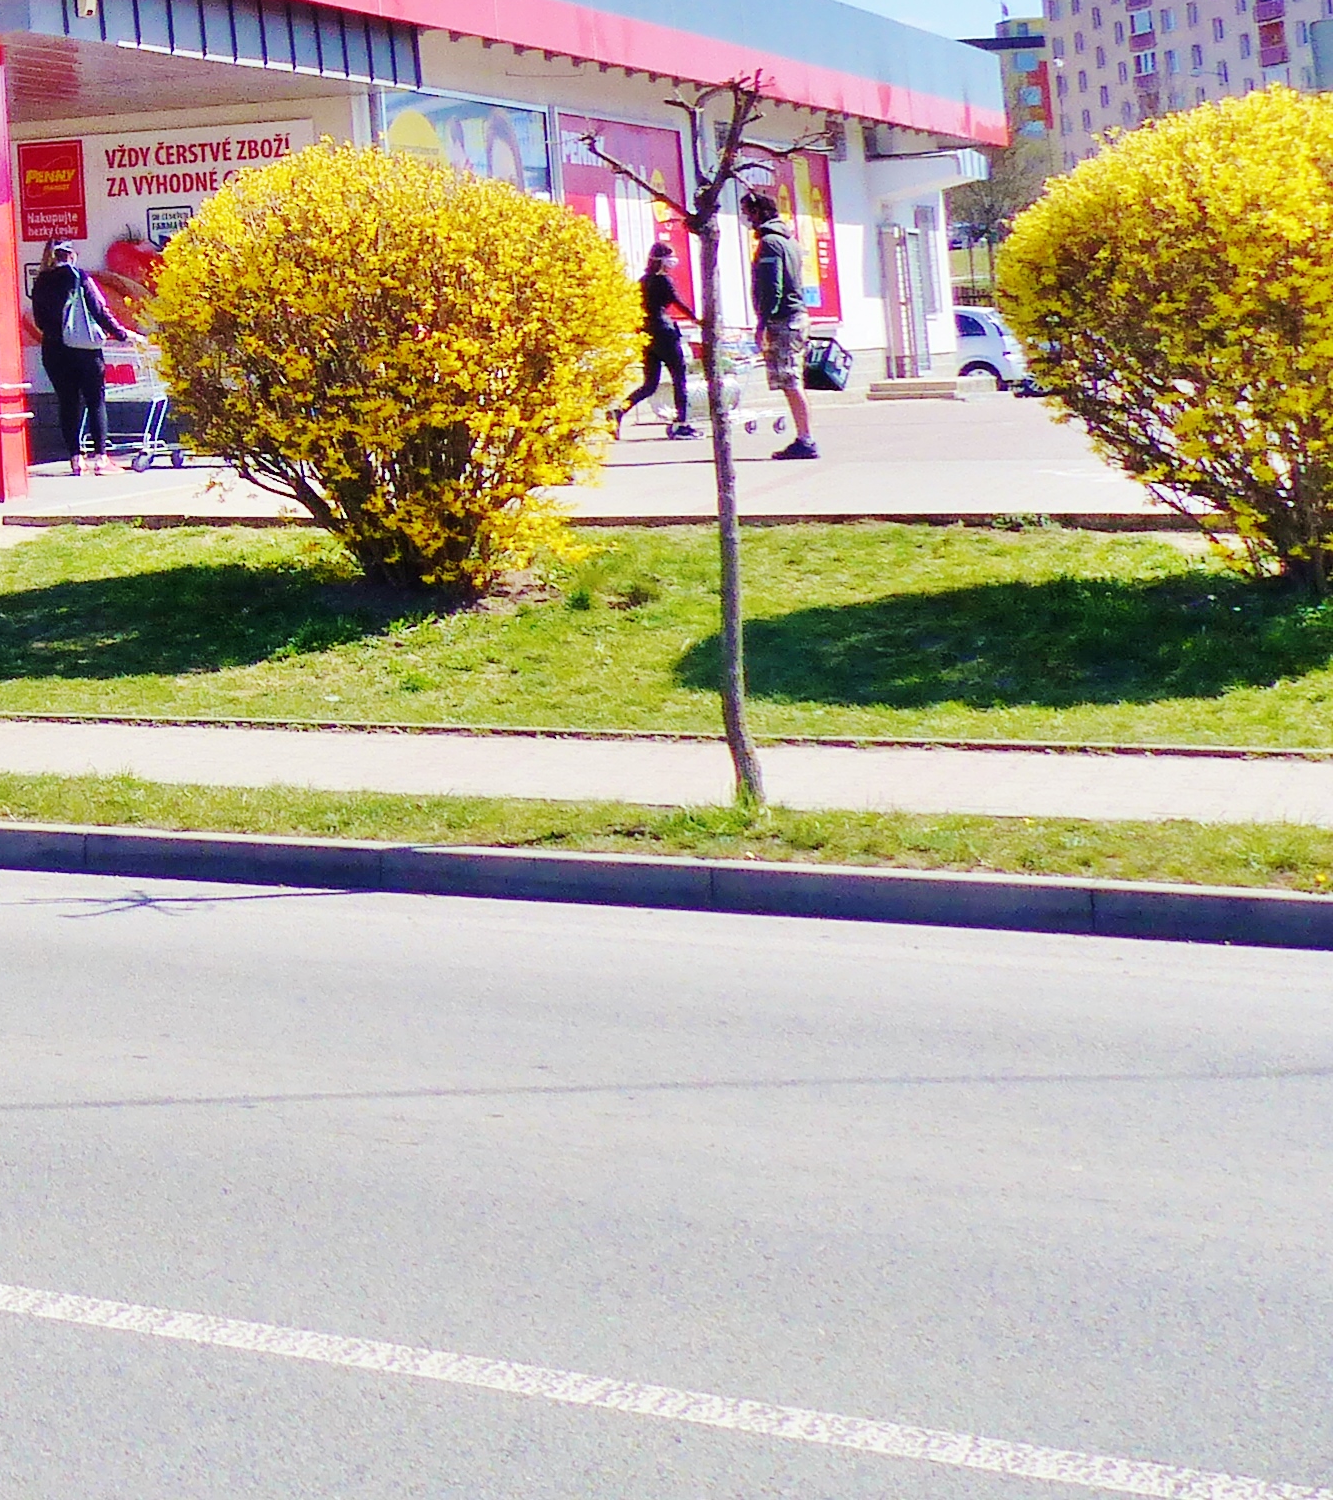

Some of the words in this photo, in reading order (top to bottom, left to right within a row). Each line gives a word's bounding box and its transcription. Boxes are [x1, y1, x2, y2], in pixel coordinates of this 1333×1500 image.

[105, 144, 151, 168] VŽDY
[154, 136, 232, 166] ČERSTVÉ
[236, 132, 291, 160] ZBOŽÍ
[25, 168, 76, 185] PENNY
[106, 177, 129, 197] ZA
[132, 167, 219, 196] VÝHODNÉ
[26, 211, 79, 226] Nakupujte
